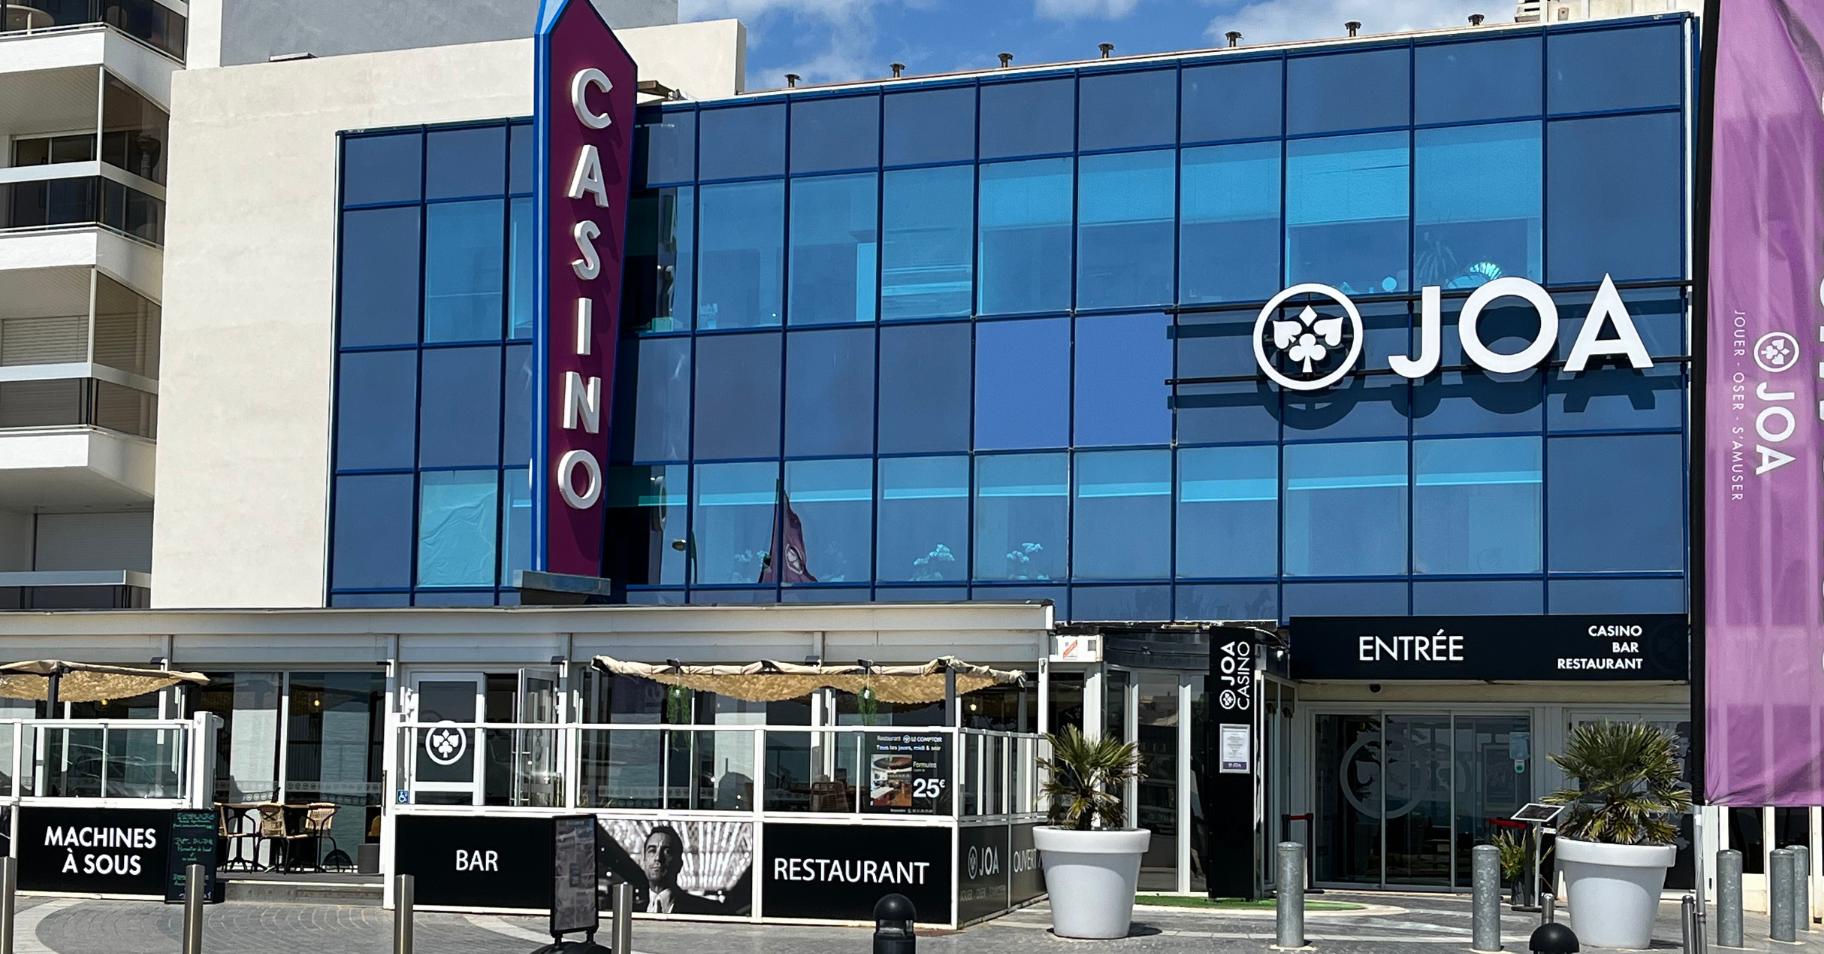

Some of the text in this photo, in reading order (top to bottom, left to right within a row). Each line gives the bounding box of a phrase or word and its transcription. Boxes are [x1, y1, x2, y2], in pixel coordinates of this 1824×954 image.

[557, 67, 614, 511] CASINO
[1387, 272, 1655, 380] JOA
[1732, 309, 1746, 356] JOUER
[1732, 372, 1745, 411] OSER
[1755, 382, 1797, 475] JOA
[1731, 426, 1744, 501] S'AMUSER
[1359, 628, 1464, 662] ENTRÉE
[1588, 625, 1643, 637] CASINO
[1612, 641, 1639, 653] BAR
[1220, 641, 1236, 686] JOA
[1237, 641, 1251, 711] CASINO
[1557, 658, 1643, 670] RESTAURANT
[44, 826, 157, 850] MACHINES
[61, 847, 142, 876] À SOUS
[455, 850, 499, 872] BAR
[773, 858, 930, 885] RESTAURANT
[978, 845, 1000, 877] JOA
[1013, 849, 1037, 873] OUVERT
